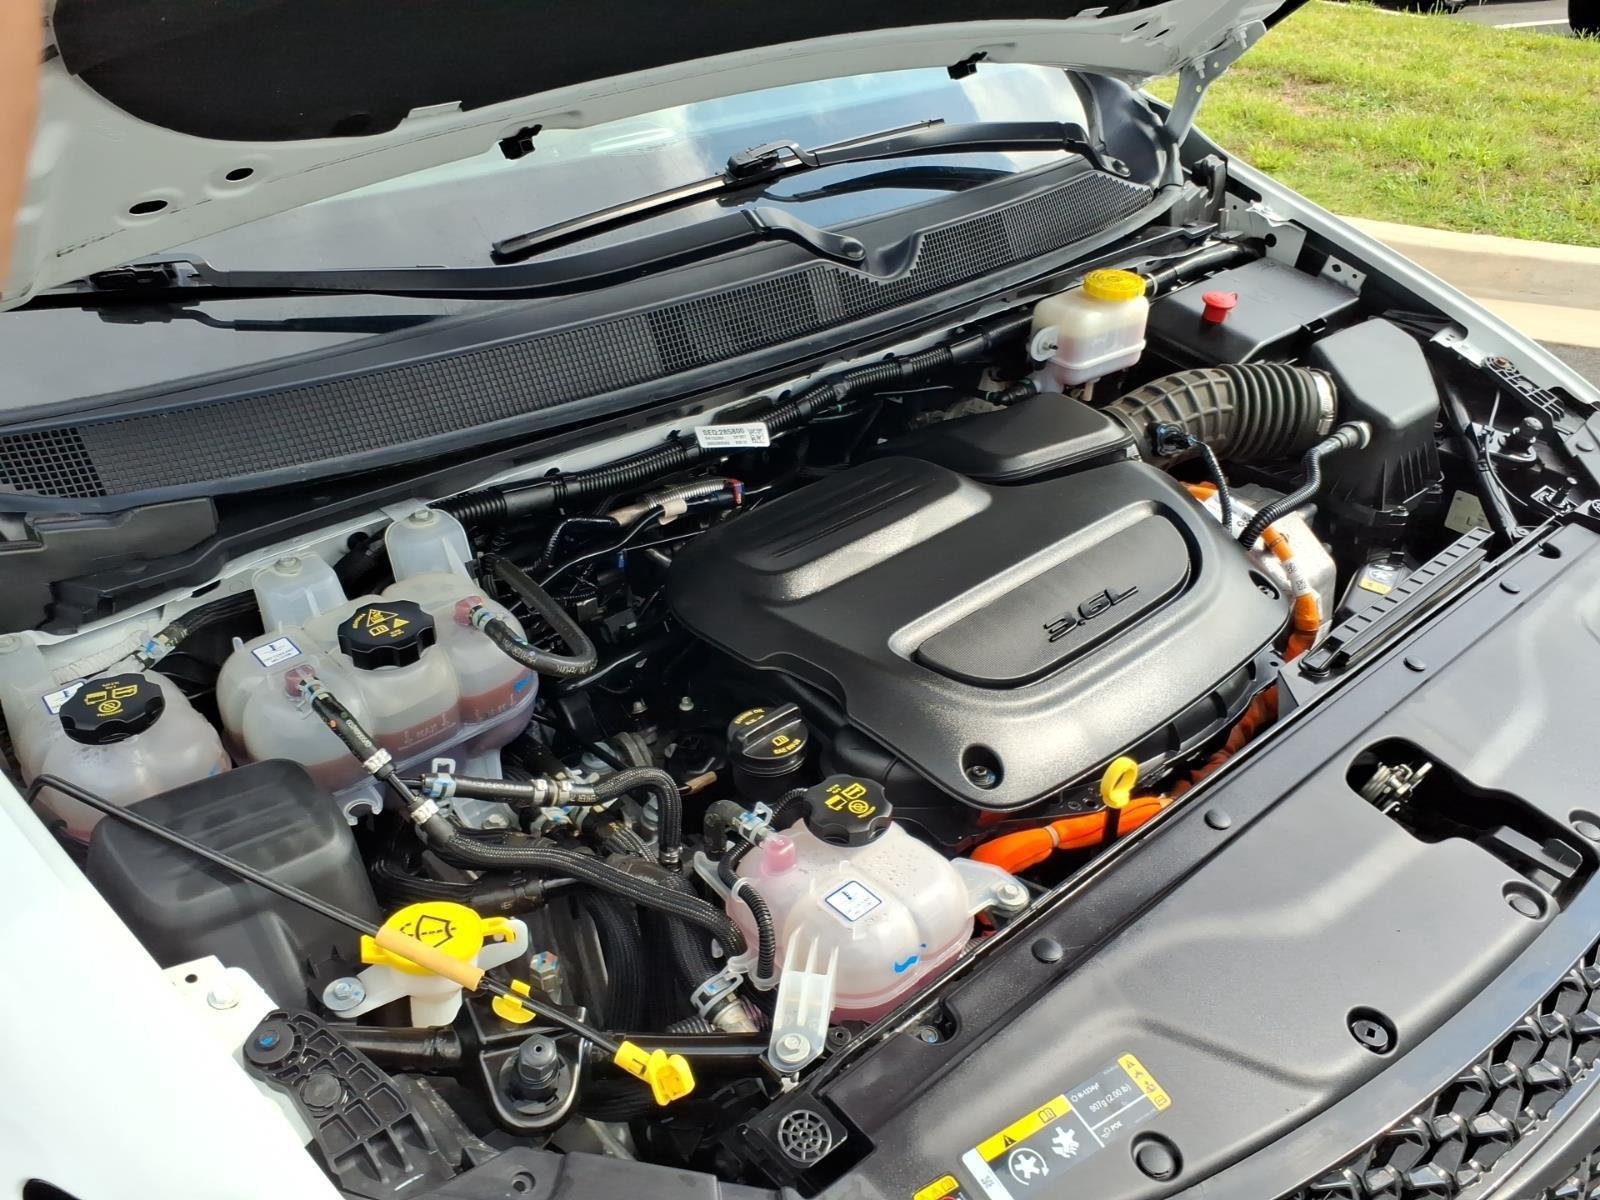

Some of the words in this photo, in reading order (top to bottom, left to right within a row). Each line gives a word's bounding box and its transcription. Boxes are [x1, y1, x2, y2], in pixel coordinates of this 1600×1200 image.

[1043, 586, 1139, 643] 3.6L
[1089, 1101, 1107, 1112] 907g
[1105, 1088, 1123, 1103] (2.00
